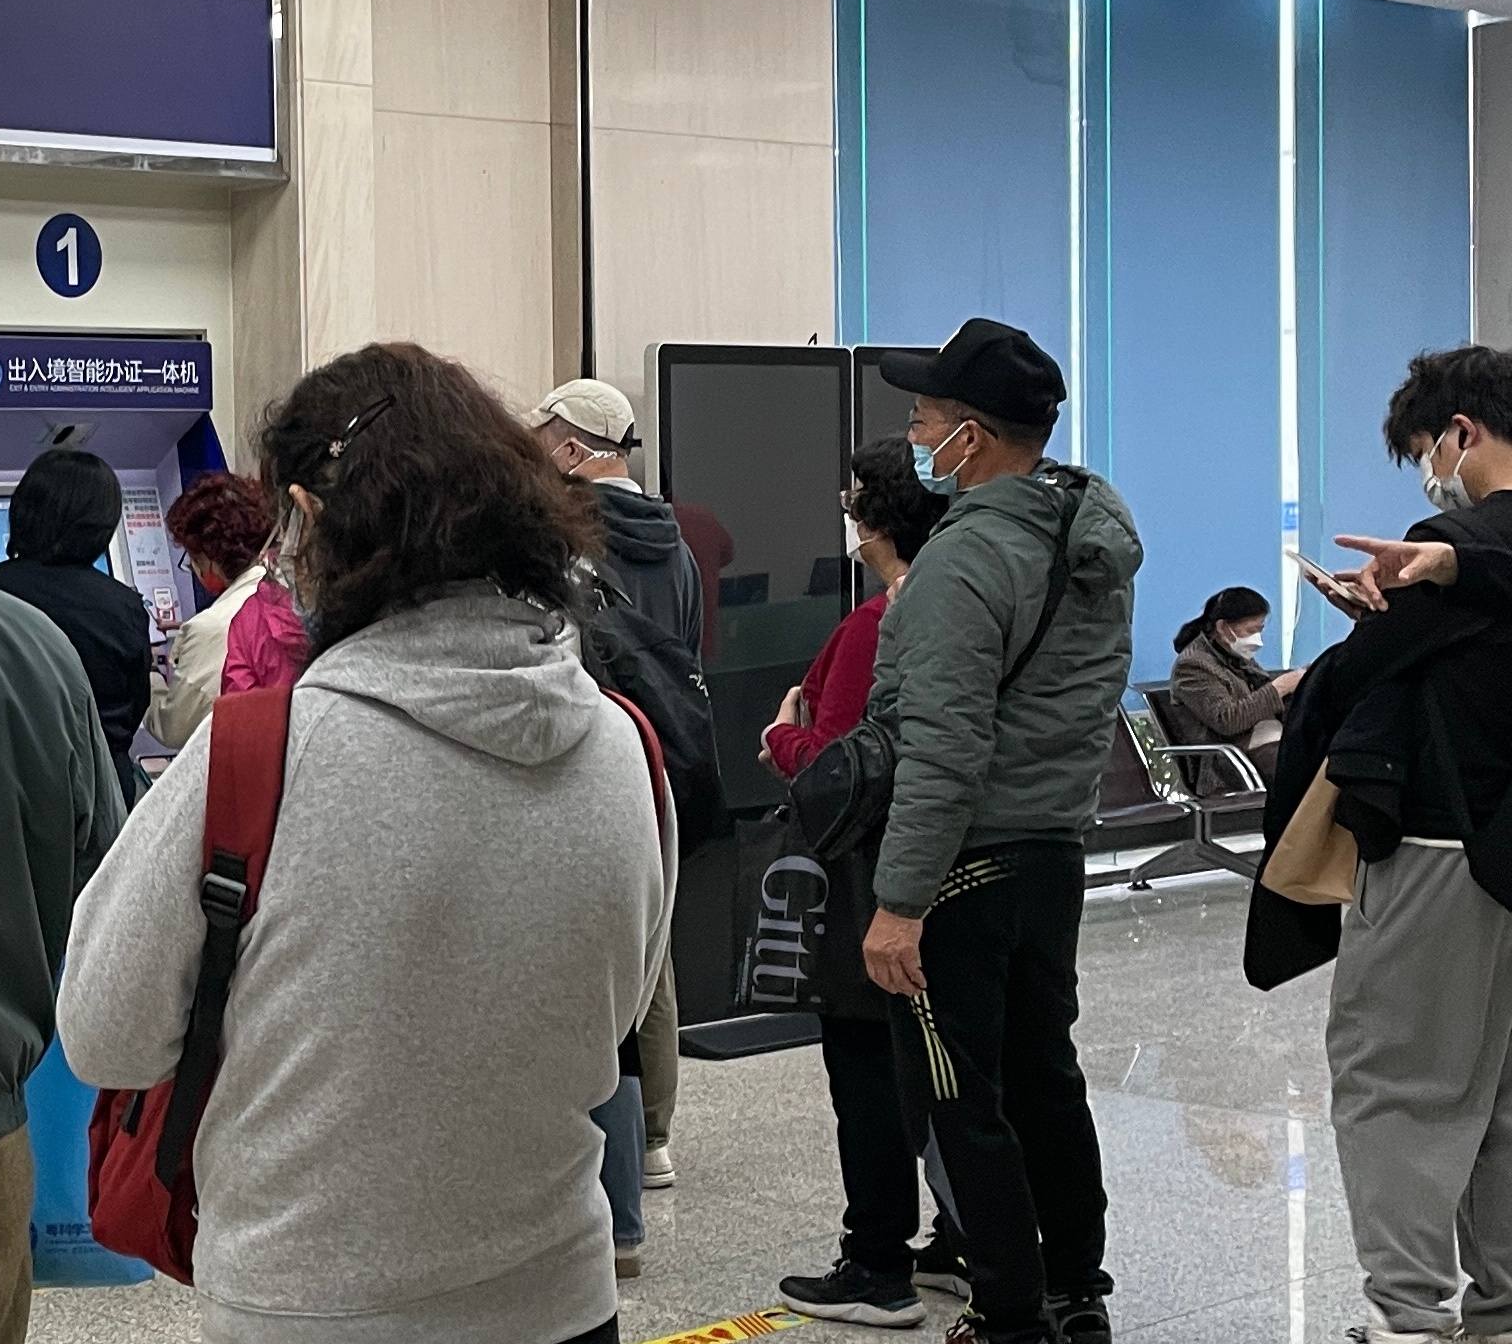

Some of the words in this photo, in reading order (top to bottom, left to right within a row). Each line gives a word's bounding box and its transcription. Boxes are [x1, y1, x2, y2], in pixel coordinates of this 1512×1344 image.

[55, 226, 80, 286] 1
[7, 357, 199, 384] 出入境智能办证一体机
[751, 855, 829, 1004] Giti
